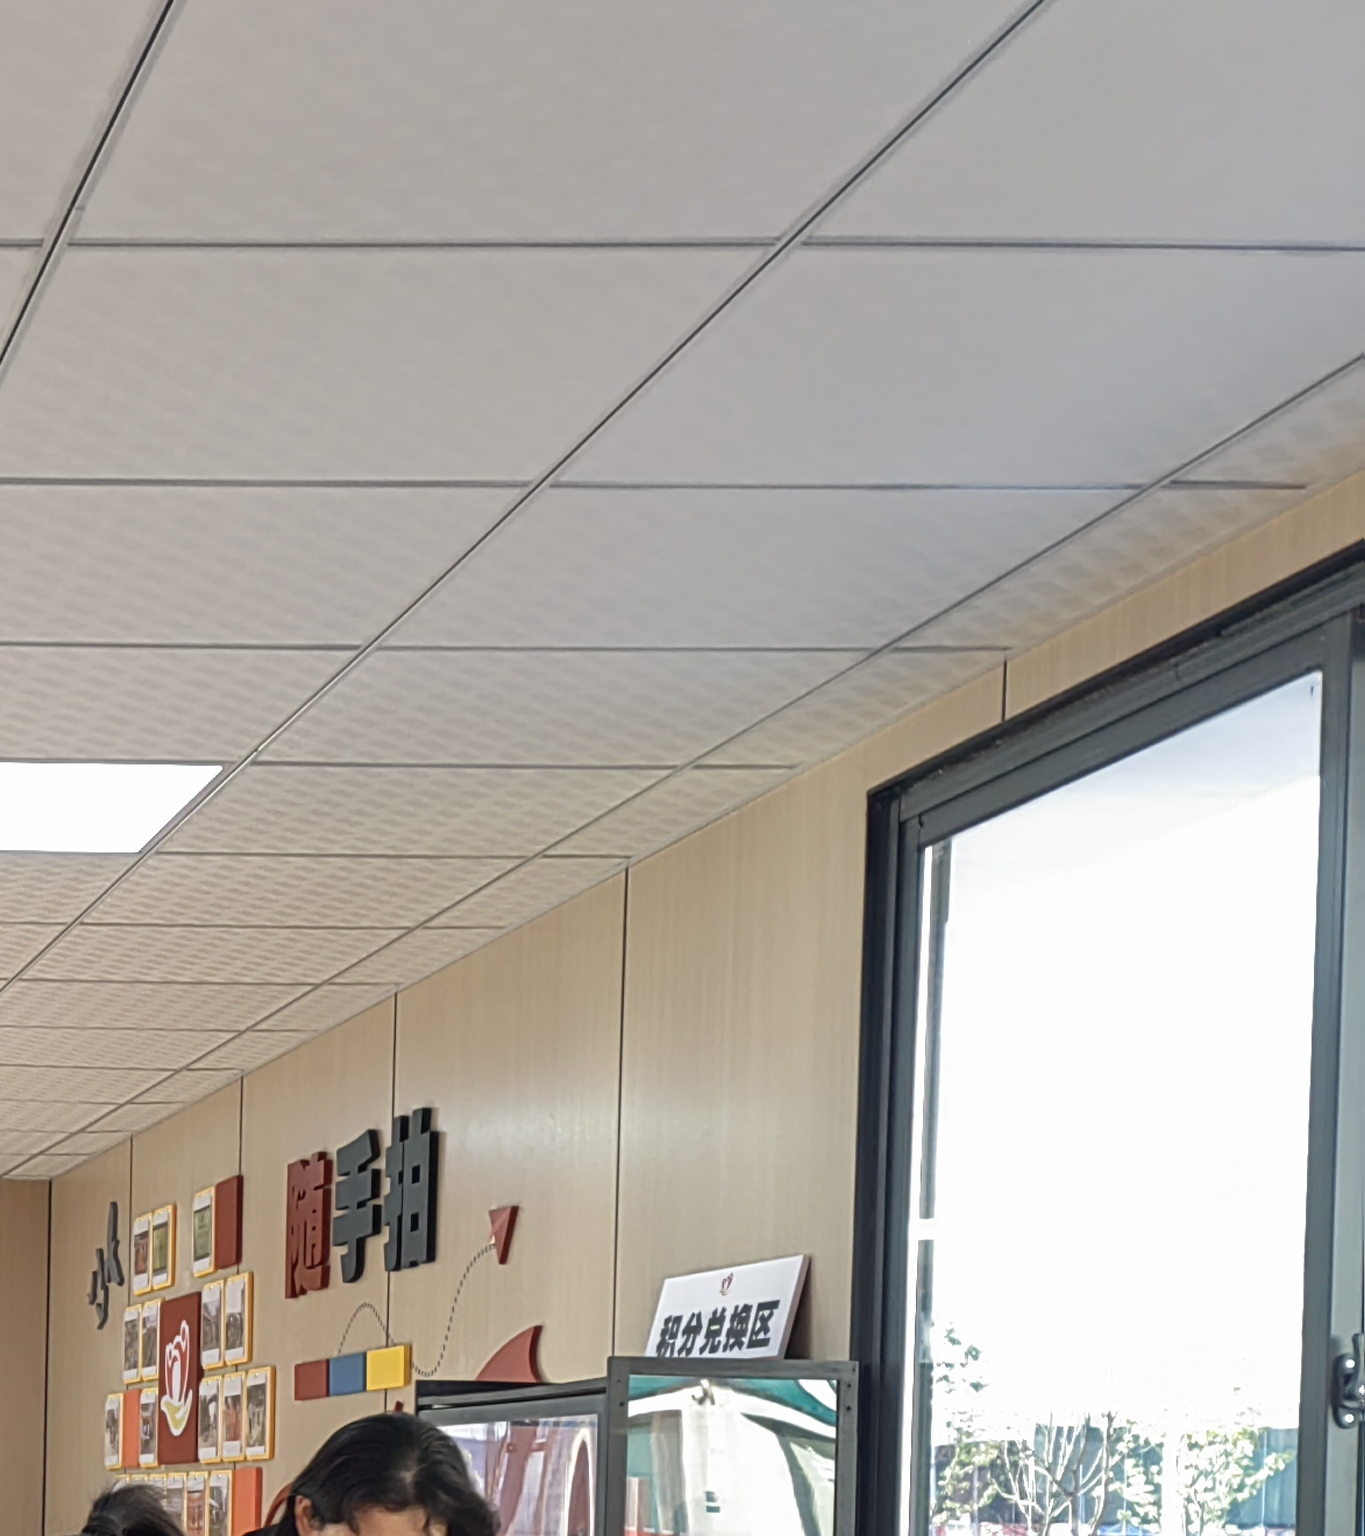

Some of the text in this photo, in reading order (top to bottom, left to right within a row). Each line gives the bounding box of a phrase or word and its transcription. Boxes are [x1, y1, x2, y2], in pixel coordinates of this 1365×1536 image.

[285, 1107, 438, 1299] 随手拍
[655, 1299, 781, 1358] 积分兑换区
